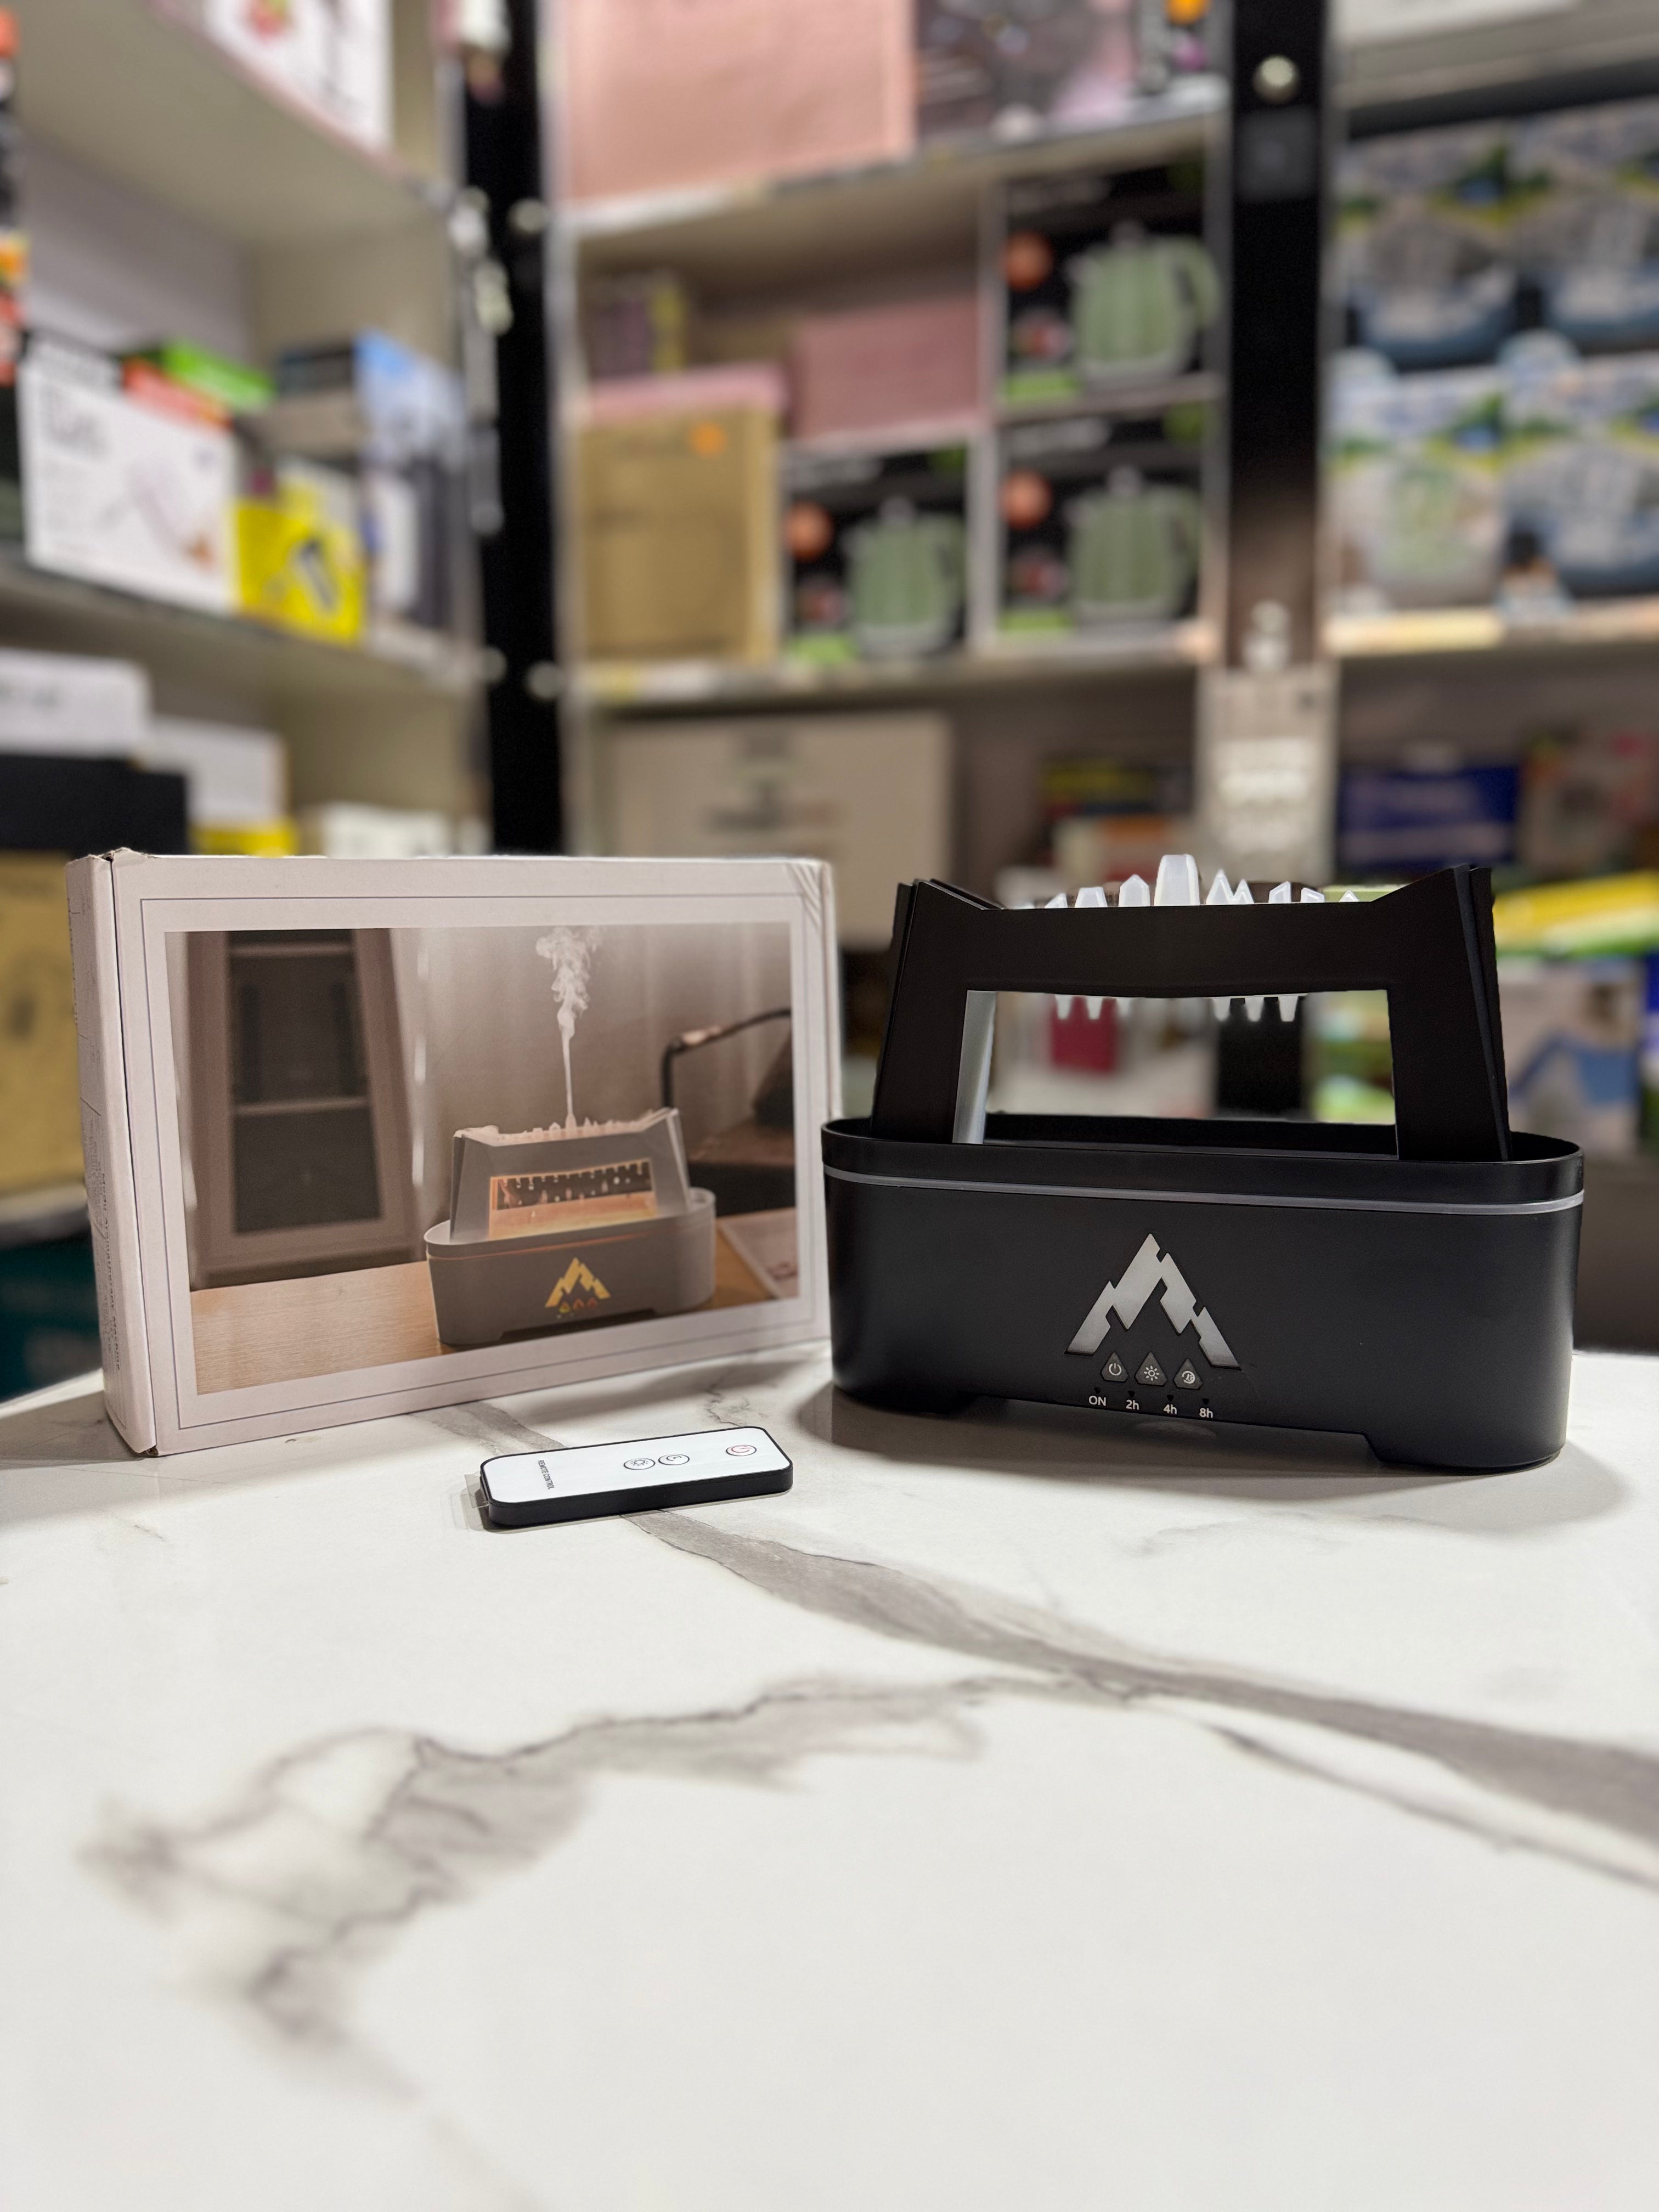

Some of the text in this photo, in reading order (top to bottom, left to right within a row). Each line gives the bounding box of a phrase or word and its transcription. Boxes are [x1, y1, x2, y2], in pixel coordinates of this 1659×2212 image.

[1088, 1395, 1214, 1419] ON 2h 4h 8h
[538, 1460, 555, 1490] REMOTE CONTROL
